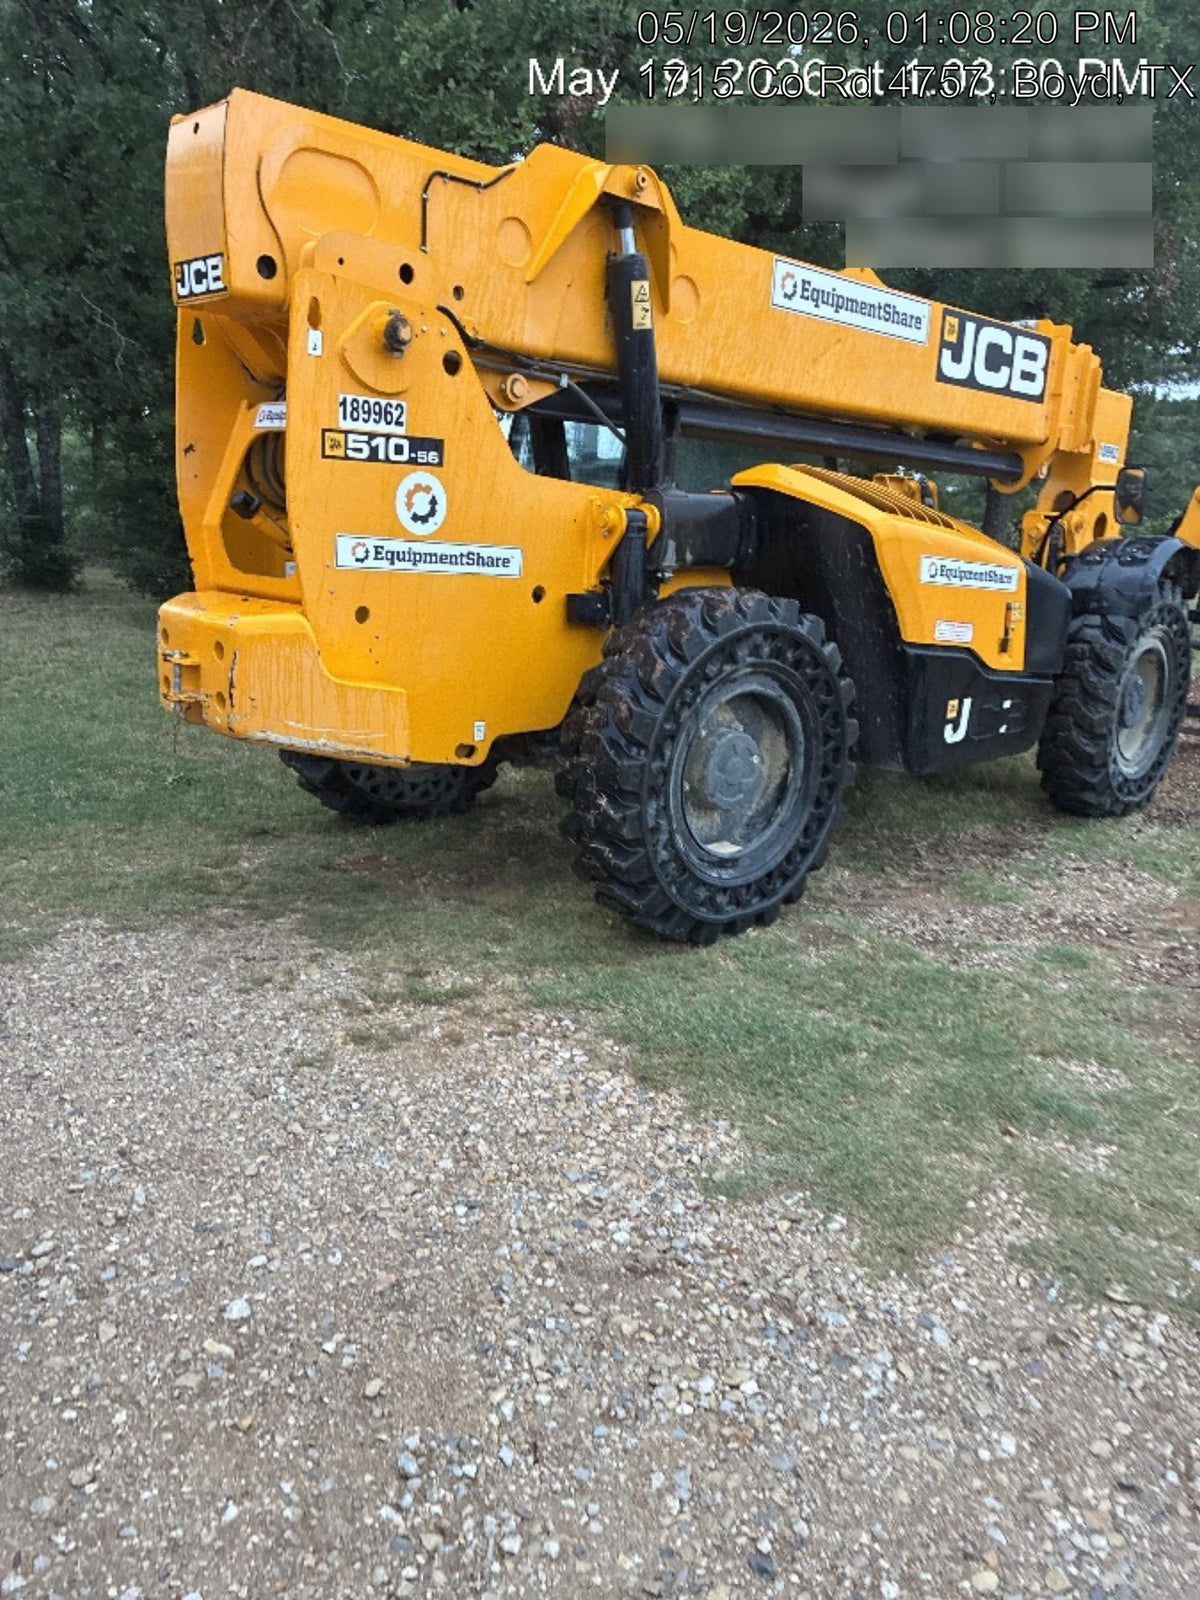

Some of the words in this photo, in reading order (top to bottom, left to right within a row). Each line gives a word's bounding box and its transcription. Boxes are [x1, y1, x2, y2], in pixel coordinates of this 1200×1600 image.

[177, 255, 225, 296] JCB
[799, 278, 923, 331] EquipmentShare
[940, 320, 1049, 396] JCB
[339, 396, 404, 428] 189962
[345, 432, 440, 465] 510-56
[372, 545, 512, 568] EquipmentShare
